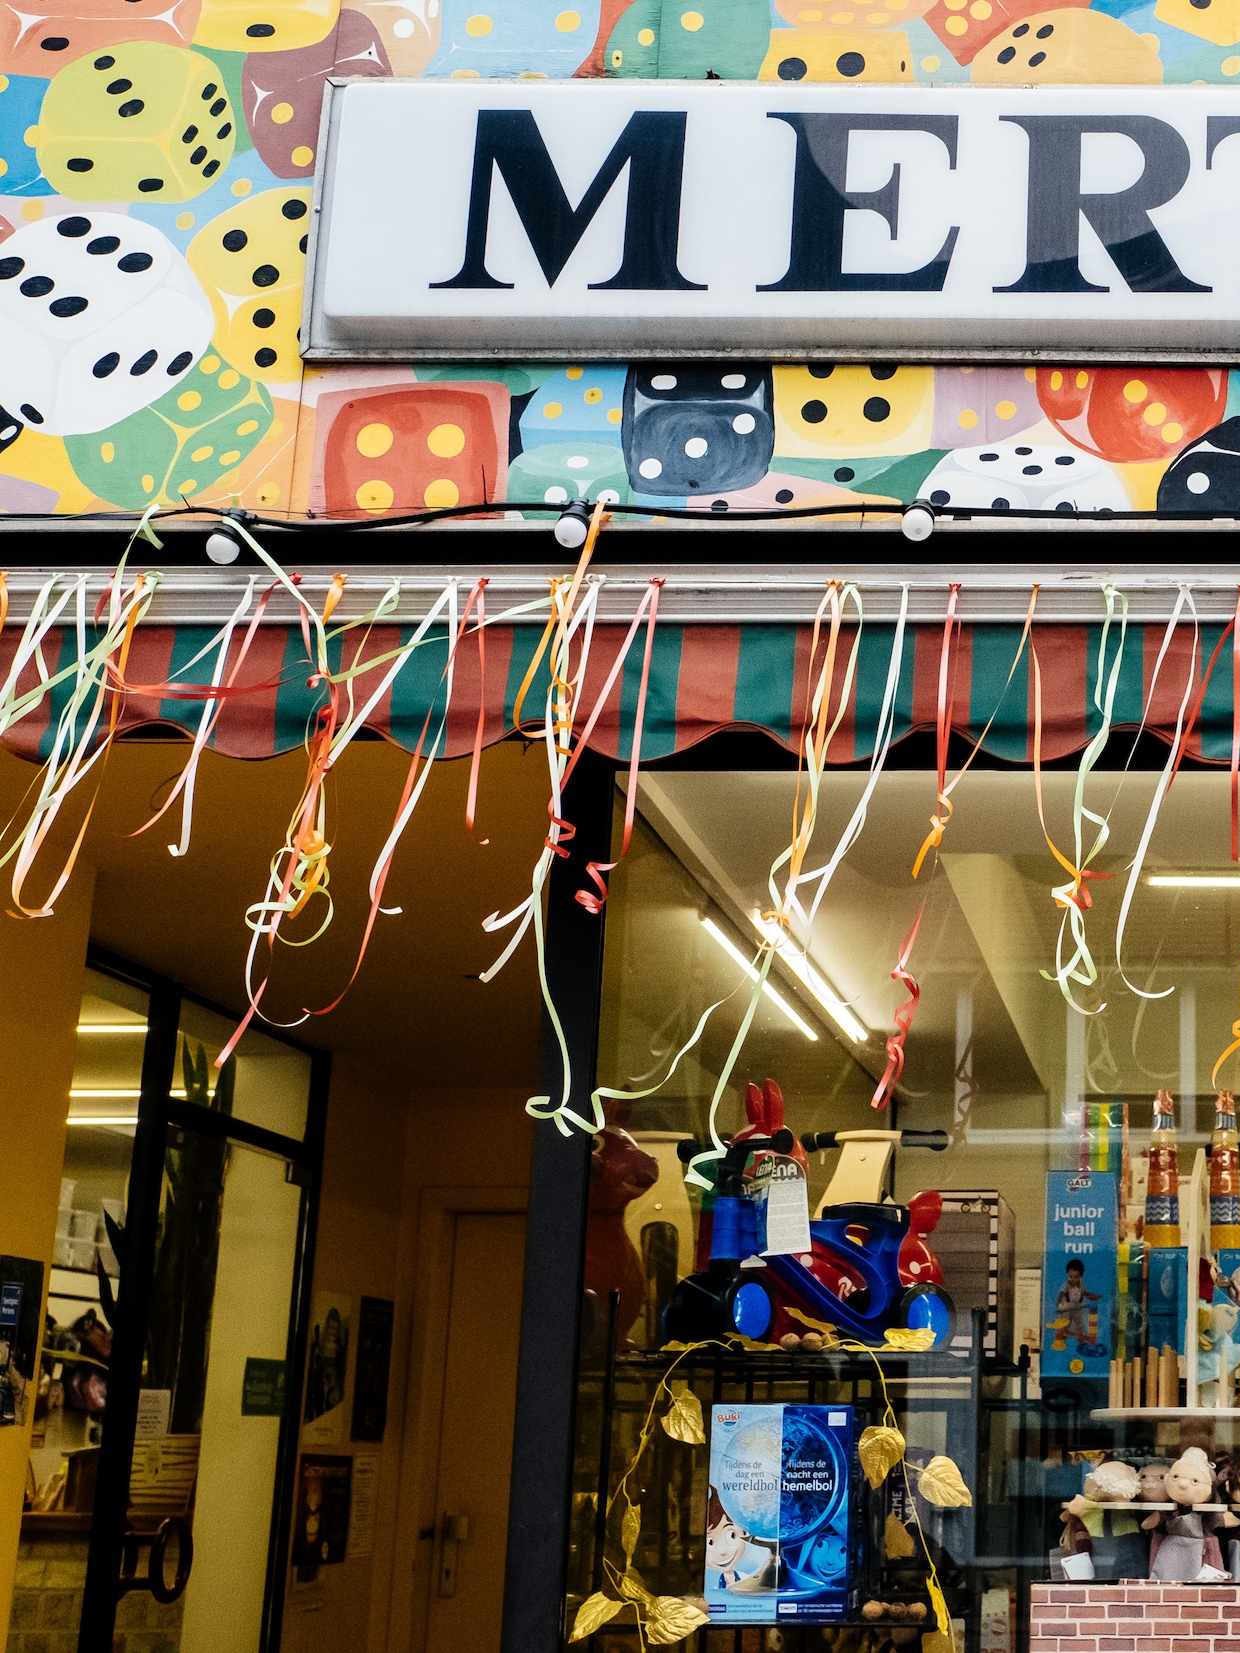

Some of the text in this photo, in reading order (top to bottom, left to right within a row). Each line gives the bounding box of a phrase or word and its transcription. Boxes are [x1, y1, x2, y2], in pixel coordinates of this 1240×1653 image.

[1054, 1204, 1105, 1221] junior
[1063, 1221, 1095, 1236] ball
[1064, 1242, 1093, 1254] run
[717, 1410, 740, 1423] Buki
[725, 1460, 762, 1470] Tijdens de
[788, 1460, 826, 1470] Tijdens de
[786, 1470, 811, 1479] nacht
[723, 1480, 778, 1491] wereldbol
[782, 1480, 832, 1491] hemelbol
